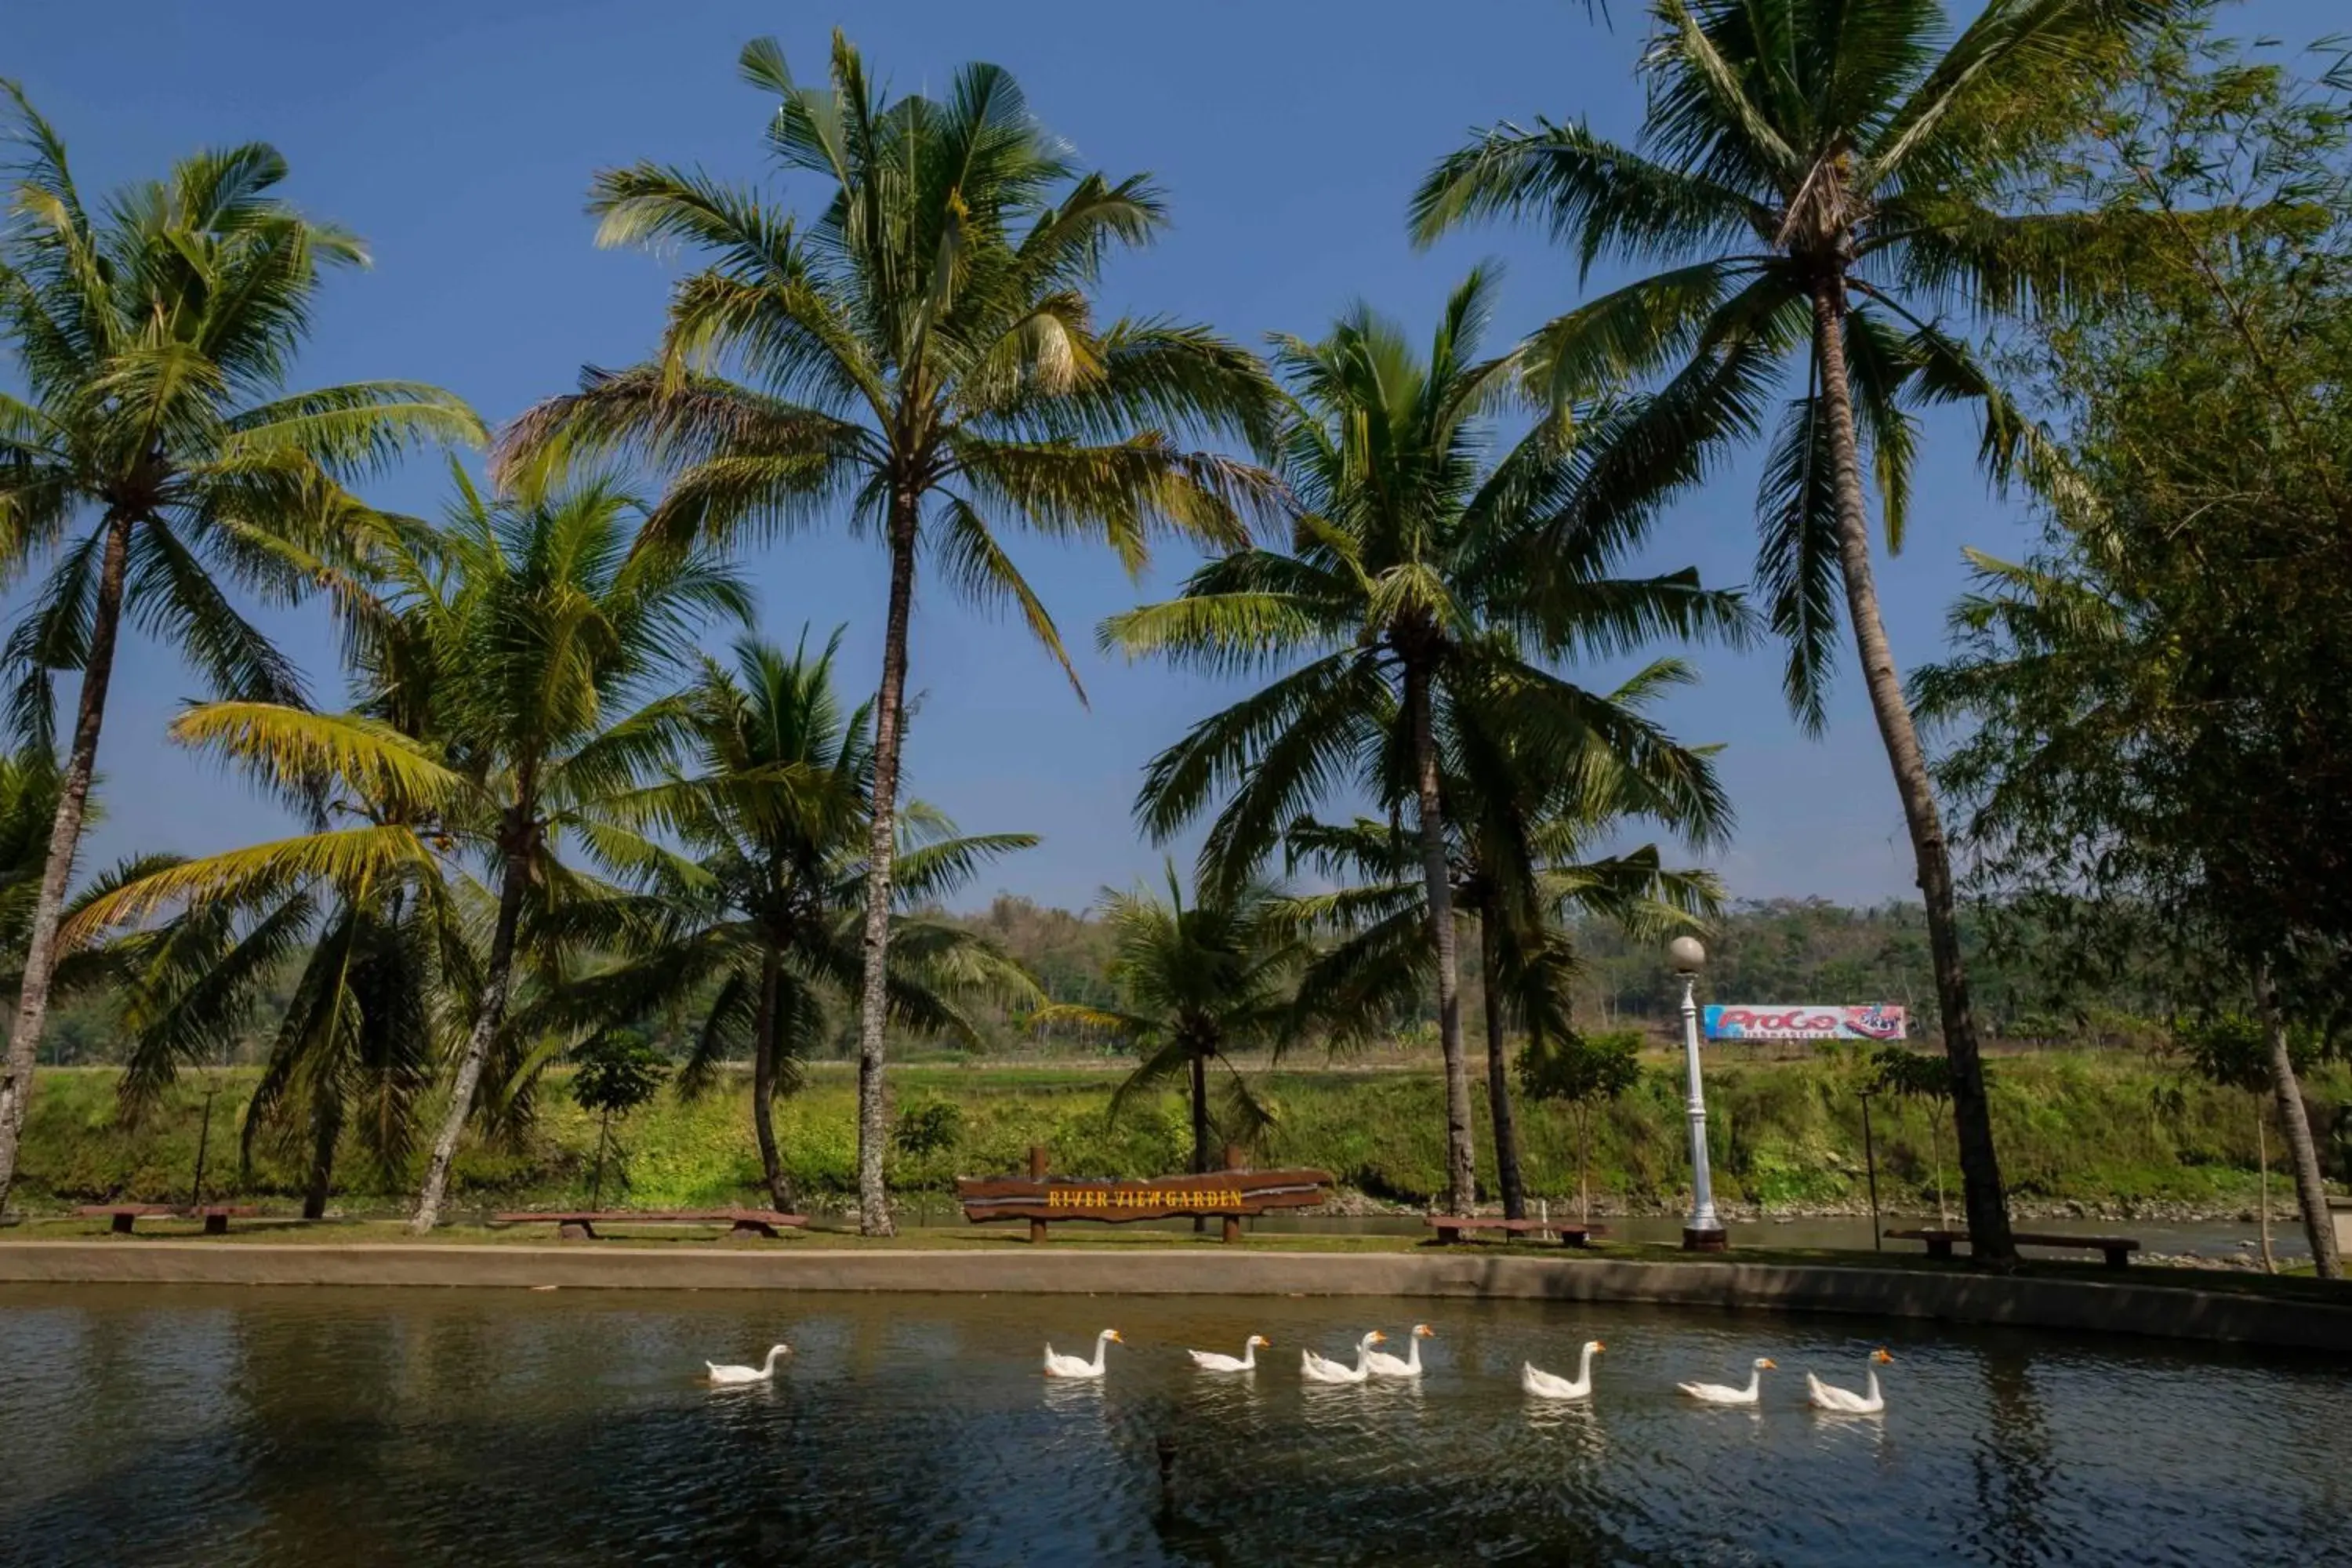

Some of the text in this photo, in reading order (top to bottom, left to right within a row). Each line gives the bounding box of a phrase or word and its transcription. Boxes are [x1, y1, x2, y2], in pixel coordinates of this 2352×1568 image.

[1049, 1190, 1242, 1207] RIVER VIEW GARDEN
